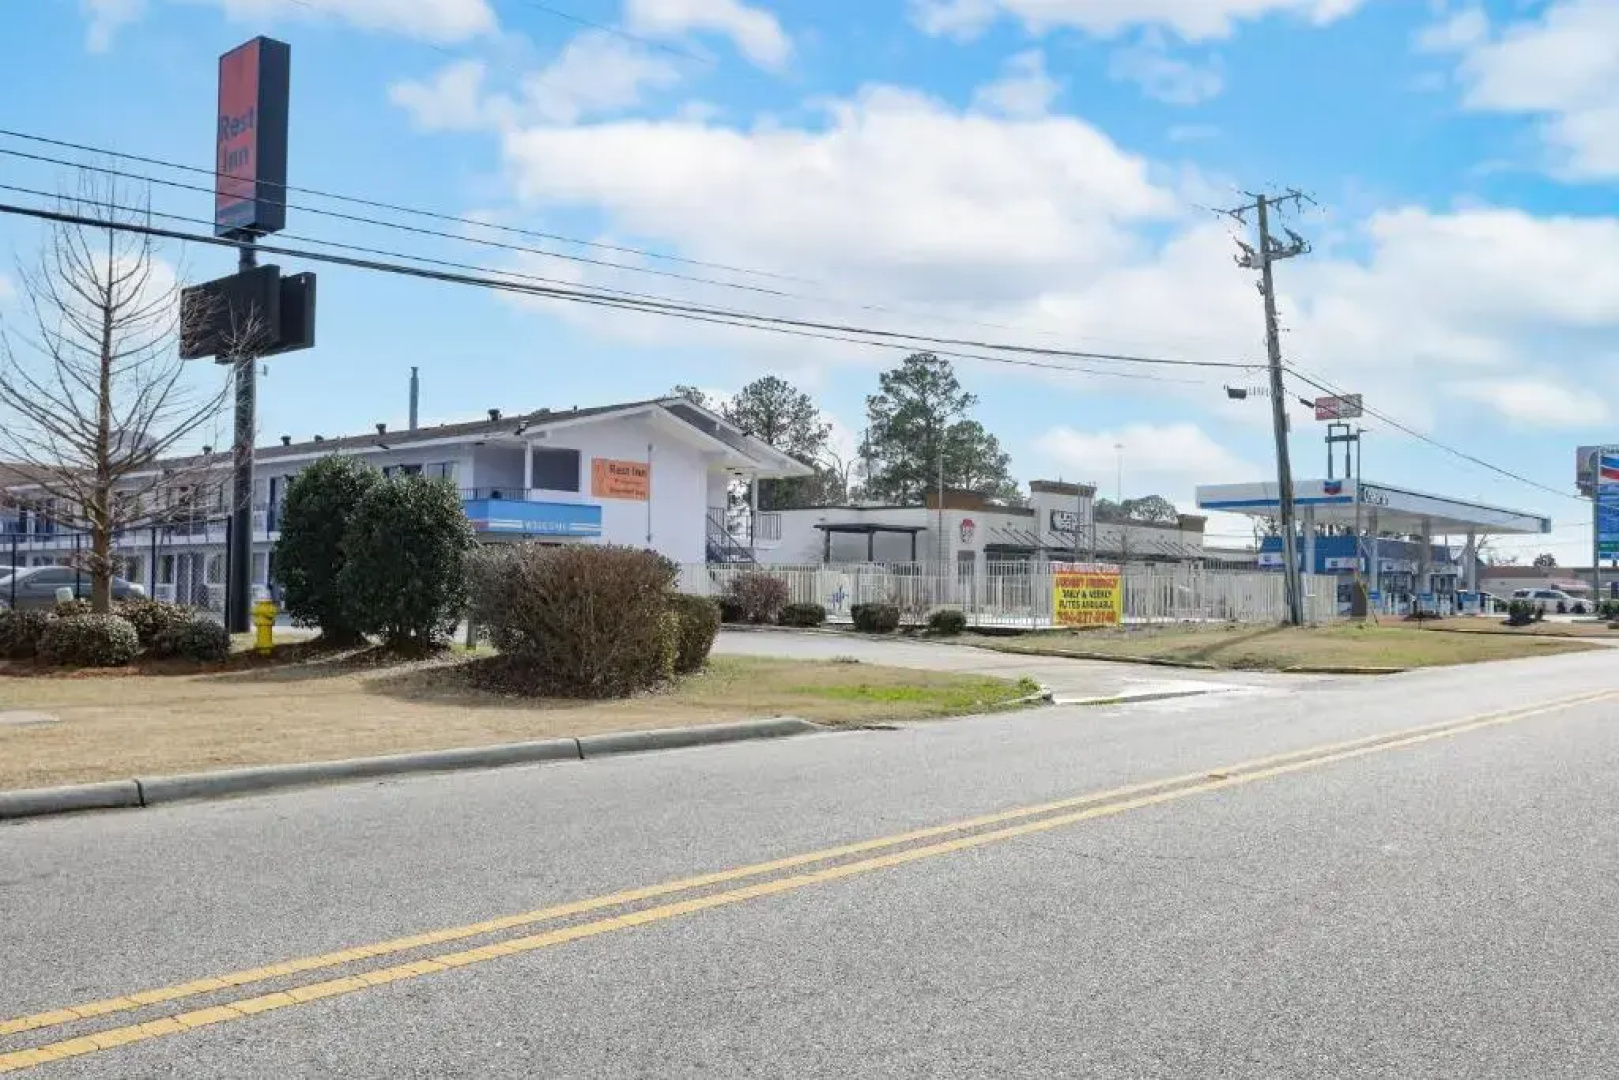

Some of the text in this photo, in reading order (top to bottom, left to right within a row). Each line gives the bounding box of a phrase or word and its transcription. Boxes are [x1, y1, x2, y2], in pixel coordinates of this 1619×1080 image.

[219, 107, 254, 141] Rest
[219, 146, 249, 172] Inn
[609, 464, 647, 477] Rest Inn
